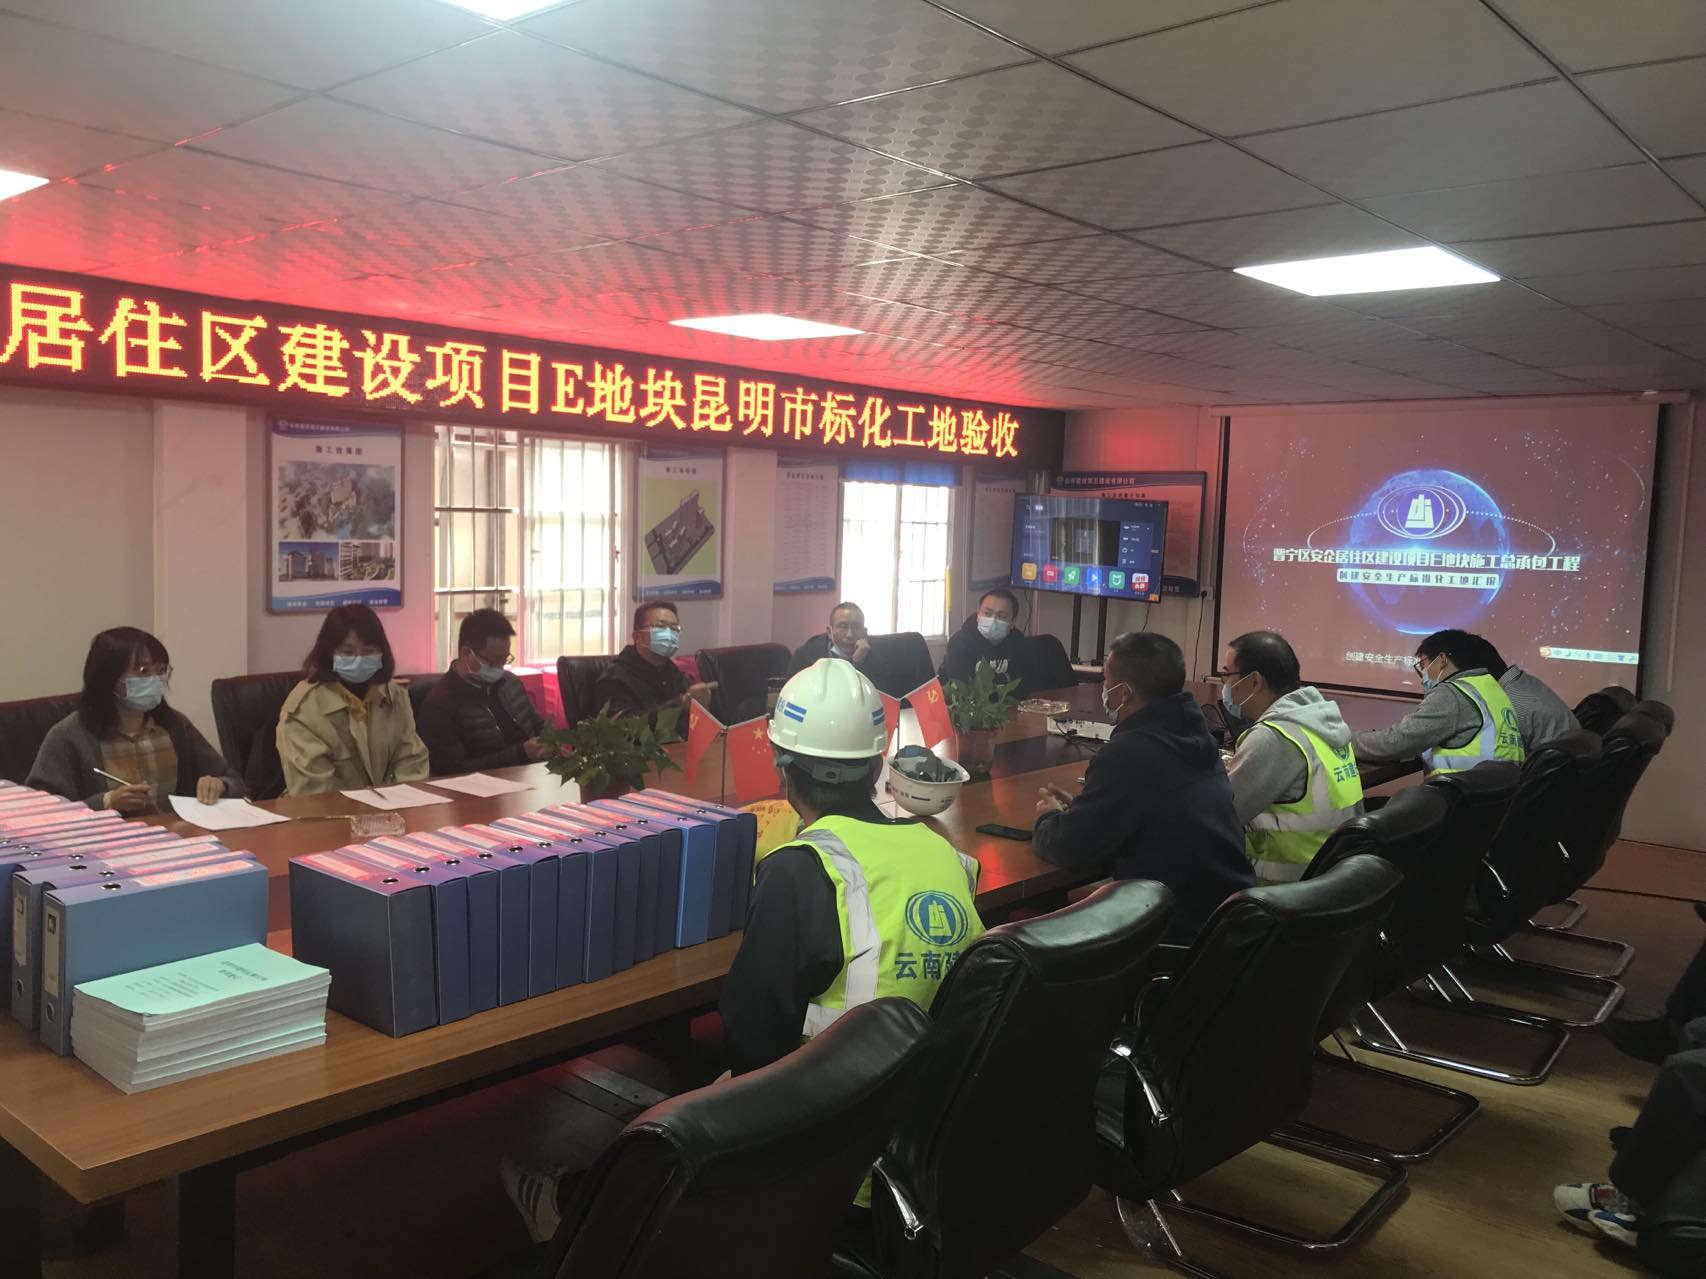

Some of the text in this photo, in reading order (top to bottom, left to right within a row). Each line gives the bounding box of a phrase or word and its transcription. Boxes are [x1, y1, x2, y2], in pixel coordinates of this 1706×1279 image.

[0, 283, 1020, 458] 居住区建设项目E地块昆明市标化工地验收
